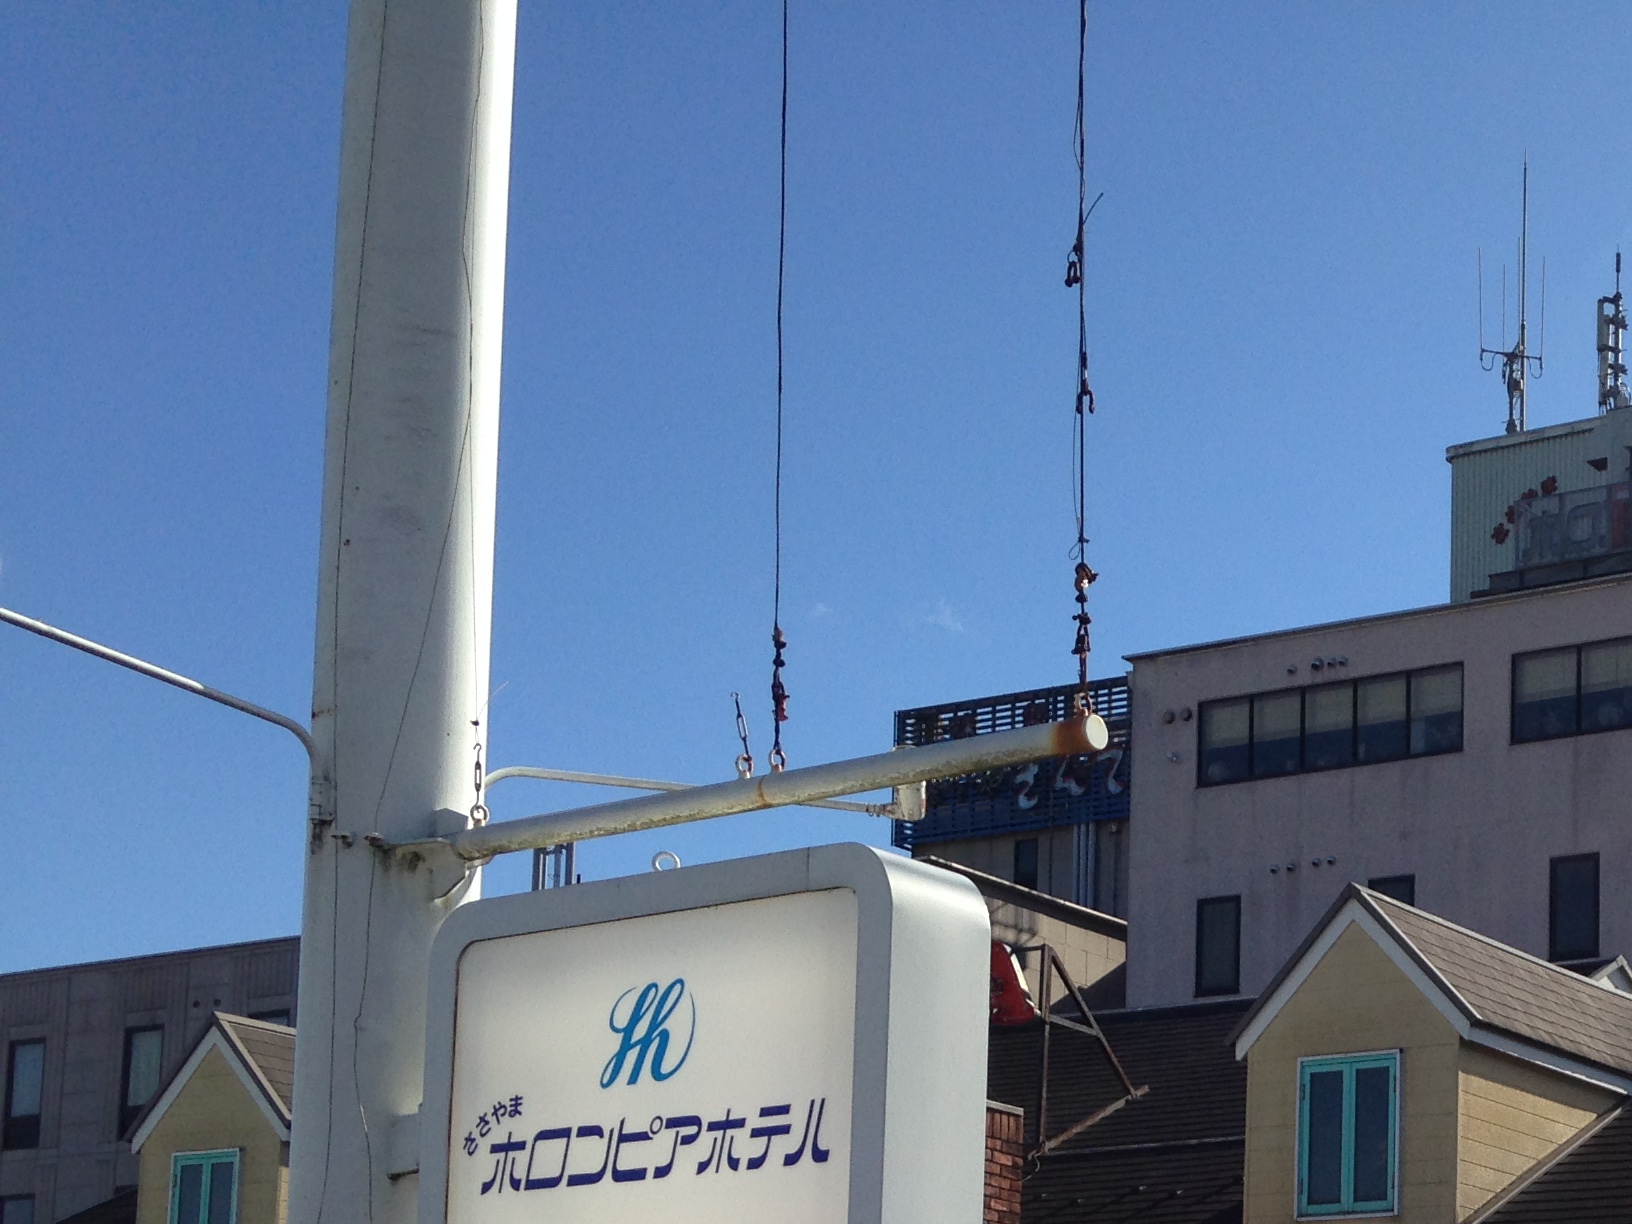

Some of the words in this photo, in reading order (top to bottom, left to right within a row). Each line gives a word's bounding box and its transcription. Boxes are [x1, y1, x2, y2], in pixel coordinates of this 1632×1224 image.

[462, 1094, 524, 1156] ささやま
[480, 1097, 830, 1195] ホロンピアホテル
